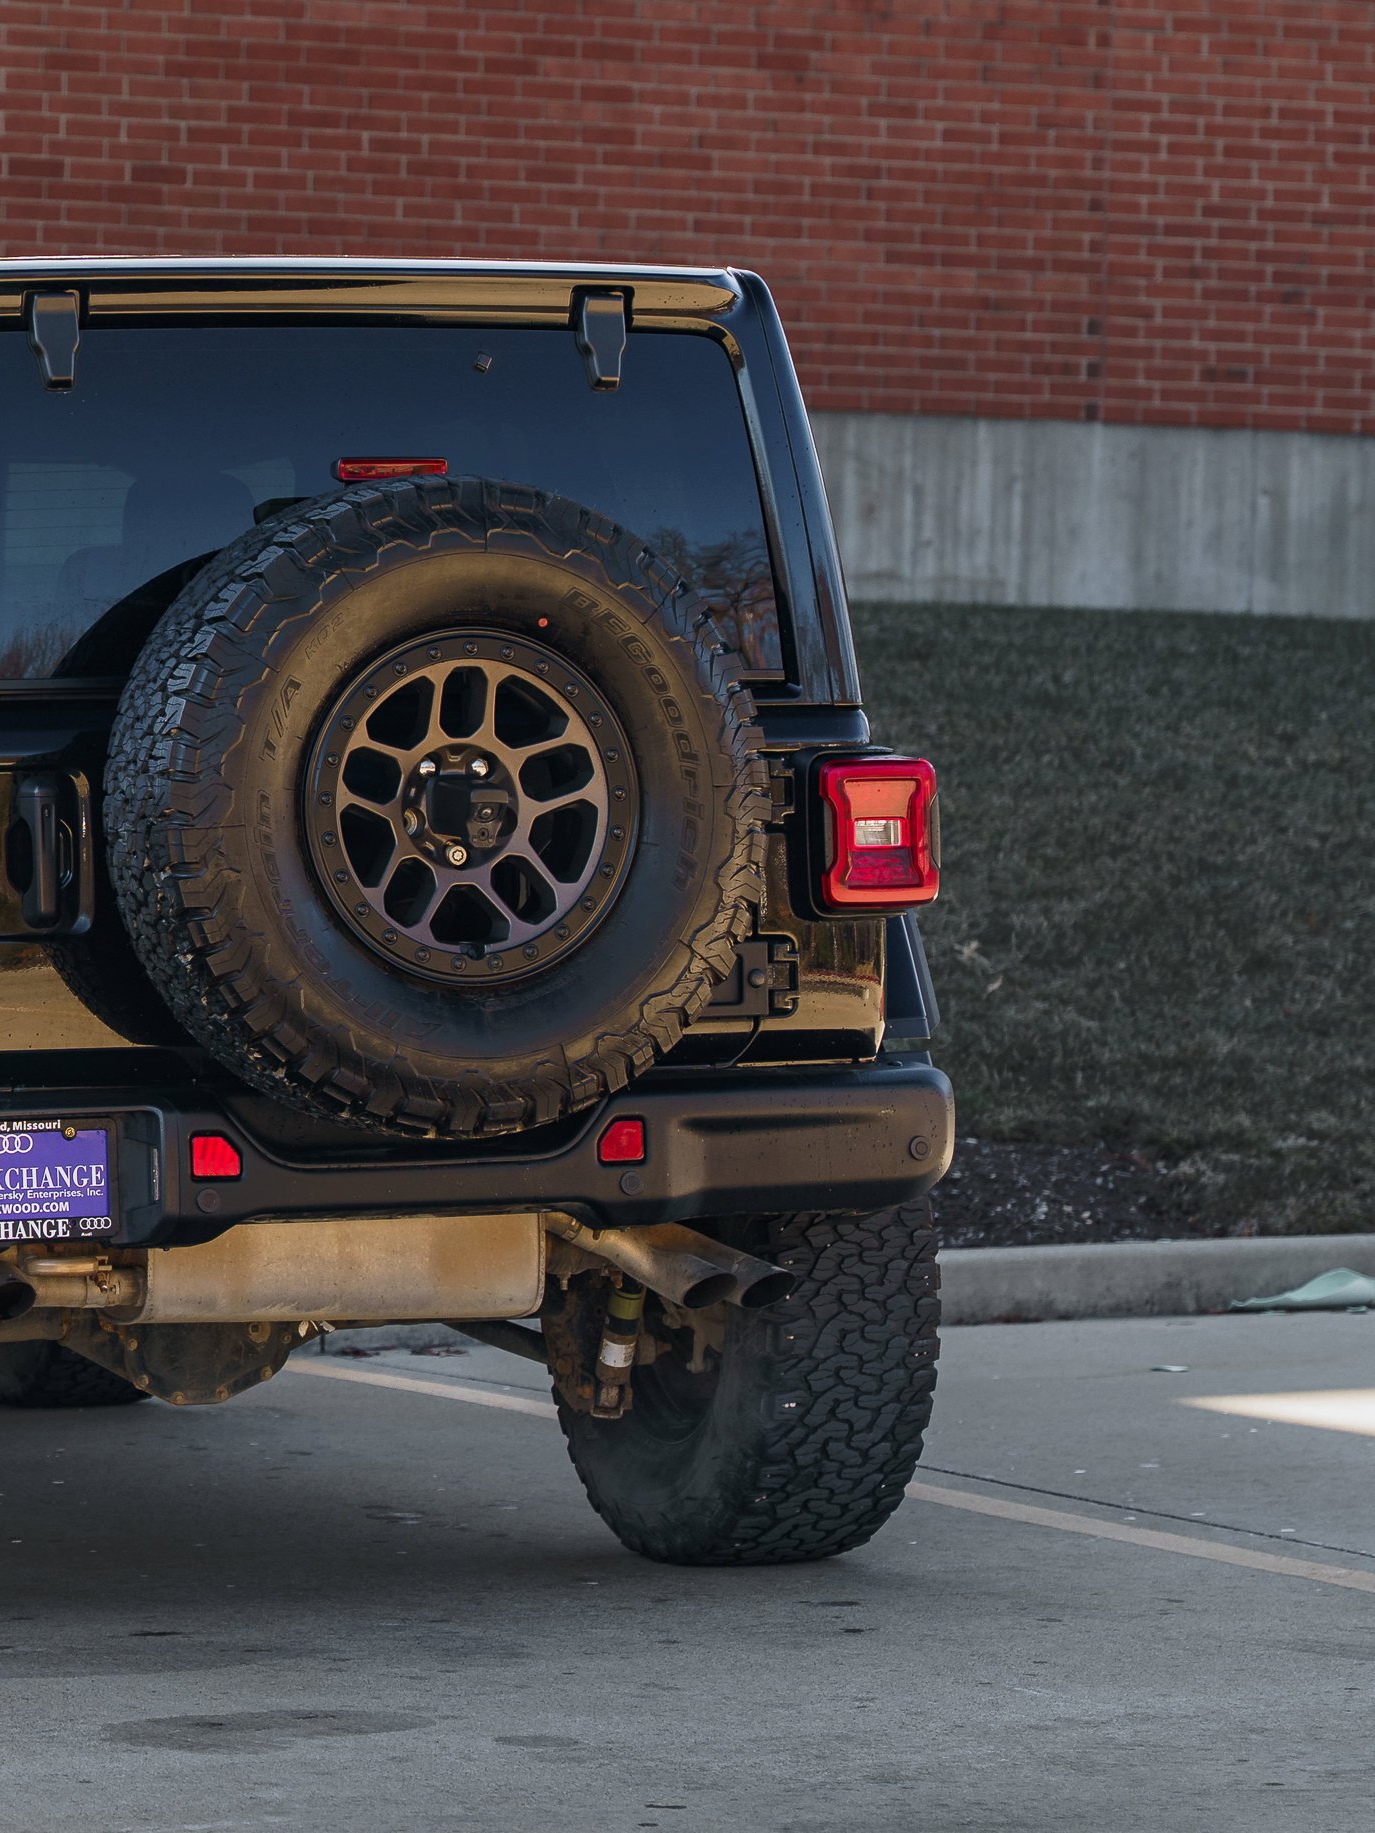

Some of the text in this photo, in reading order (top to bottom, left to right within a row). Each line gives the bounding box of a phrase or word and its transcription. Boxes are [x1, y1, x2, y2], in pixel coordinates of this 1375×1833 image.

[12, 1120, 61, 1131] Missouri
[26, 1187, 84, 1199] Enterprises,
[86, 1187, 104, 1197] Inc.
